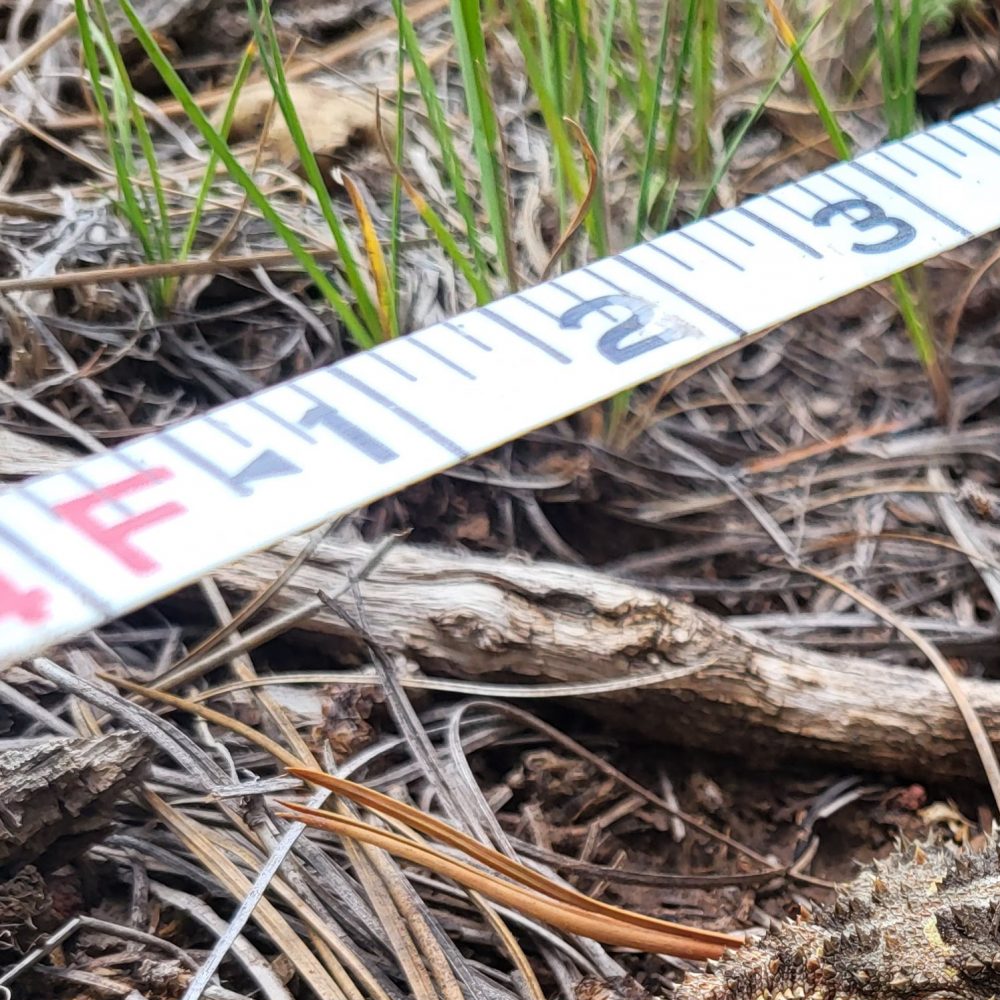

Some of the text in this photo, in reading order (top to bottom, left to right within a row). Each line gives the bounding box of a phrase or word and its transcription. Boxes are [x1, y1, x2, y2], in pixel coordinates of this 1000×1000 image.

[300, 405, 399, 464] 1
[560, 294, 702, 365] 2
[813, 199, 917, 254] 3
